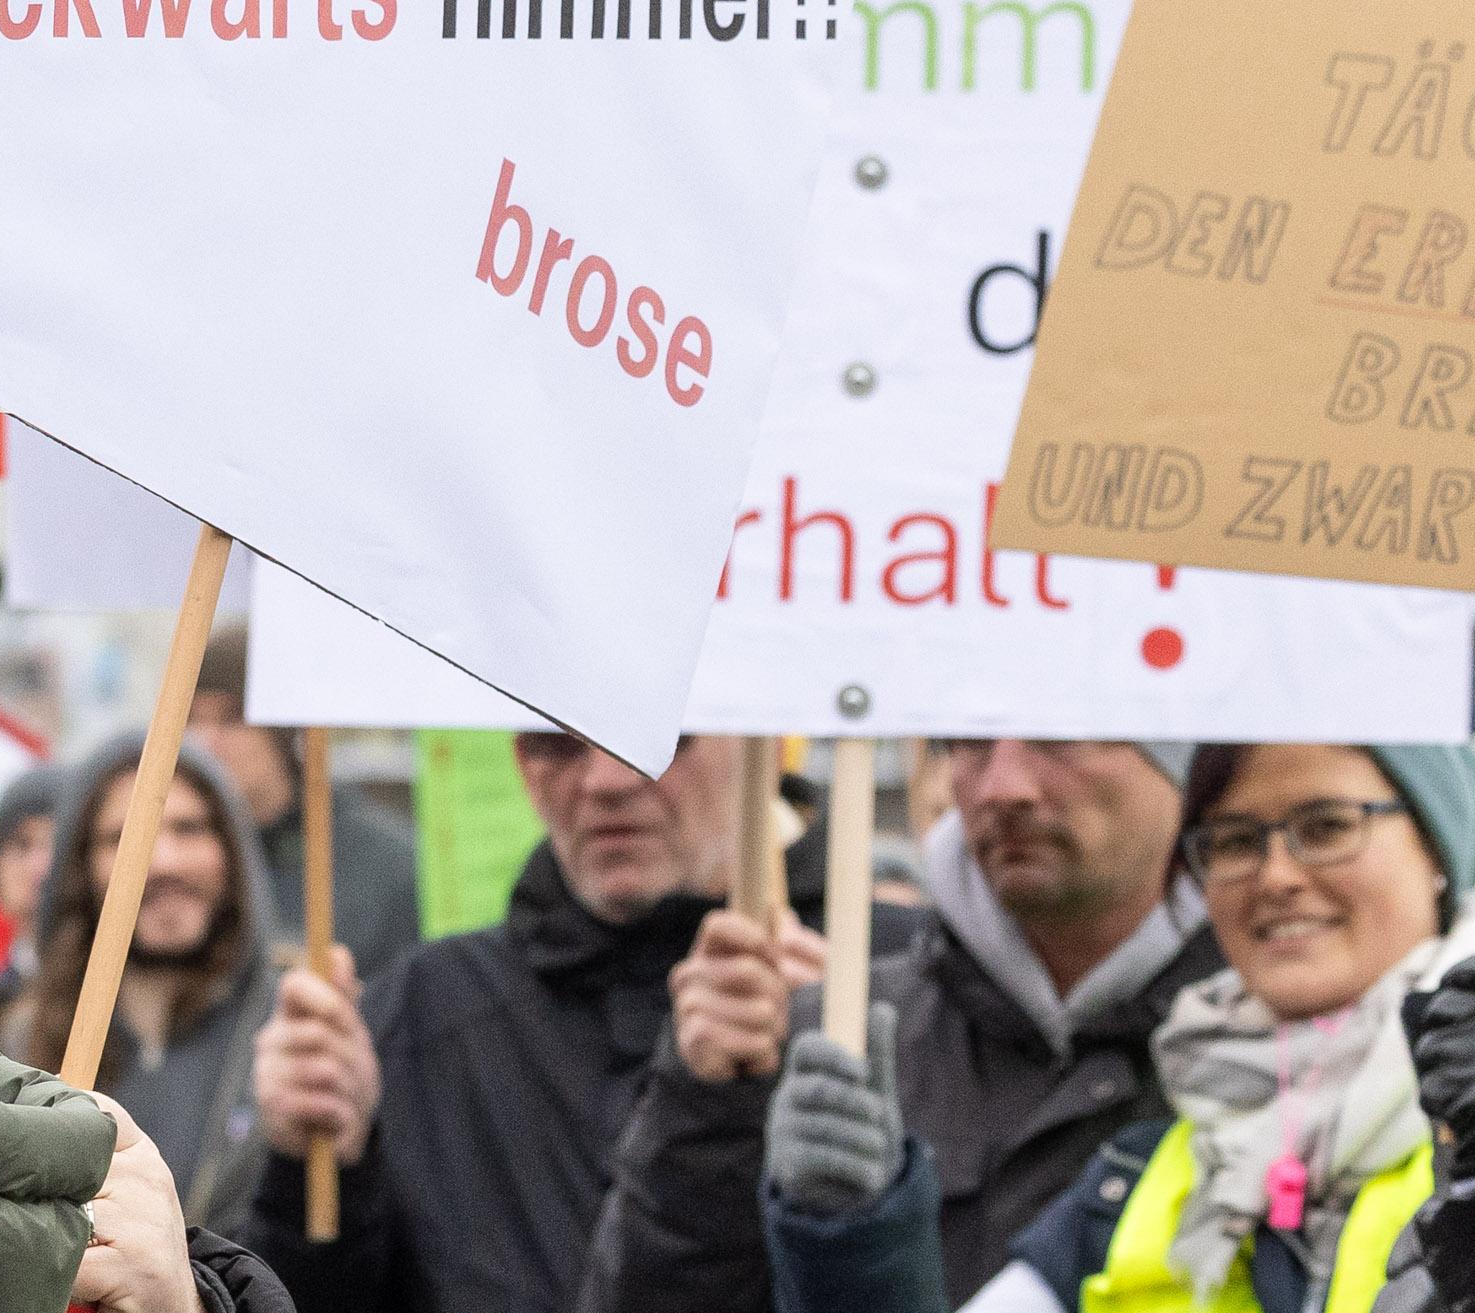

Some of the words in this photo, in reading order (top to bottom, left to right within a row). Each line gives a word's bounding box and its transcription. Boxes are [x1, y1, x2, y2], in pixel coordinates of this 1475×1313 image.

[475, 158, 714, 408] brose
[1094, 181, 1291, 285] DEN
[1027, 441, 1206, 534] UND
